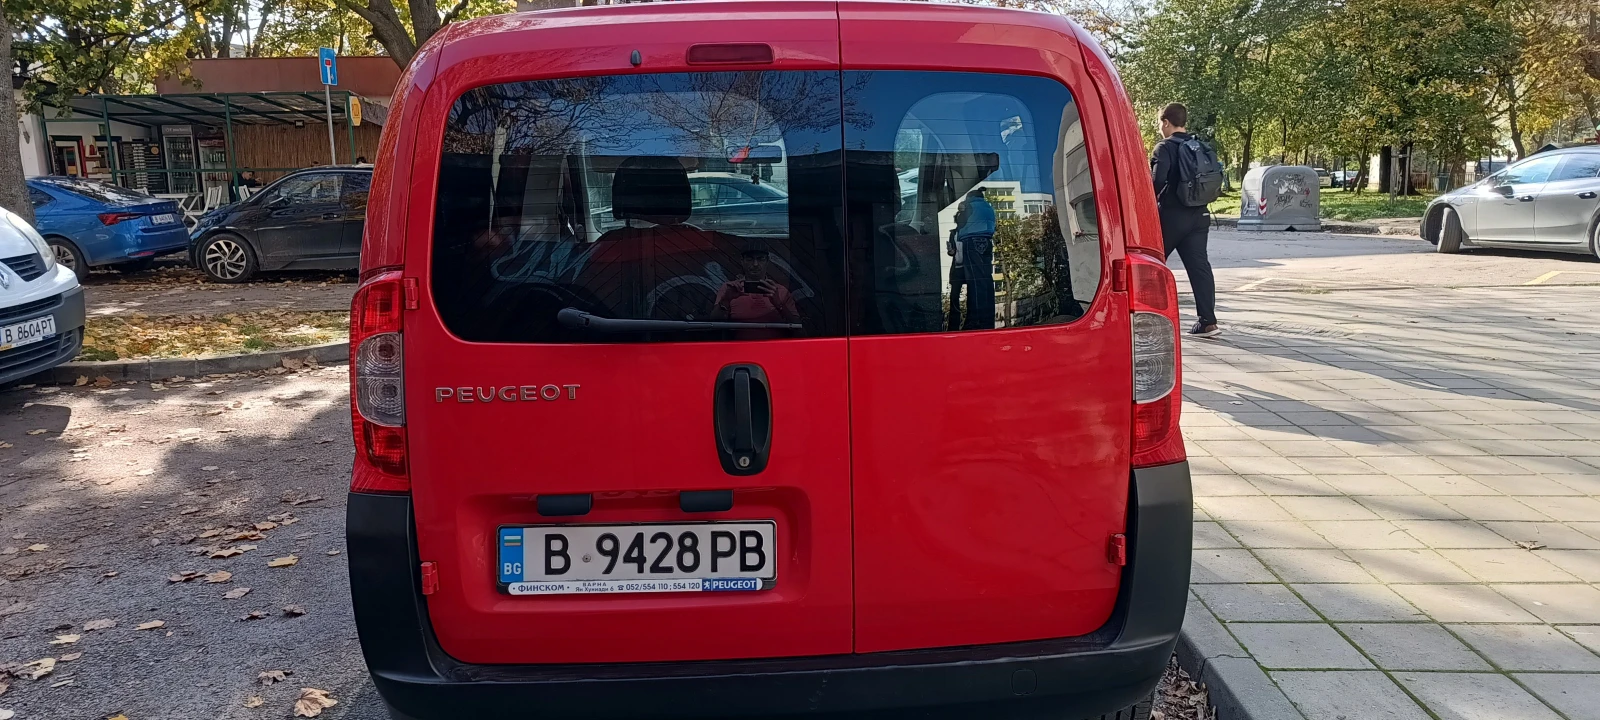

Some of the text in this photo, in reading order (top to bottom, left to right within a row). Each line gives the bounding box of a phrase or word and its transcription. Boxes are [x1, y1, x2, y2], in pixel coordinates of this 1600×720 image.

[5, 329, 13, 344] B
[435, 384, 581, 403] PEUGEOT
[544, 533, 571, 575] B
[504, 562, 521, 575] BG
[518, 584, 564, 593] ФИНСКОМ
[626, 583, 656, 591] 052/554
[713, 580, 756, 589] PEUGEOT
